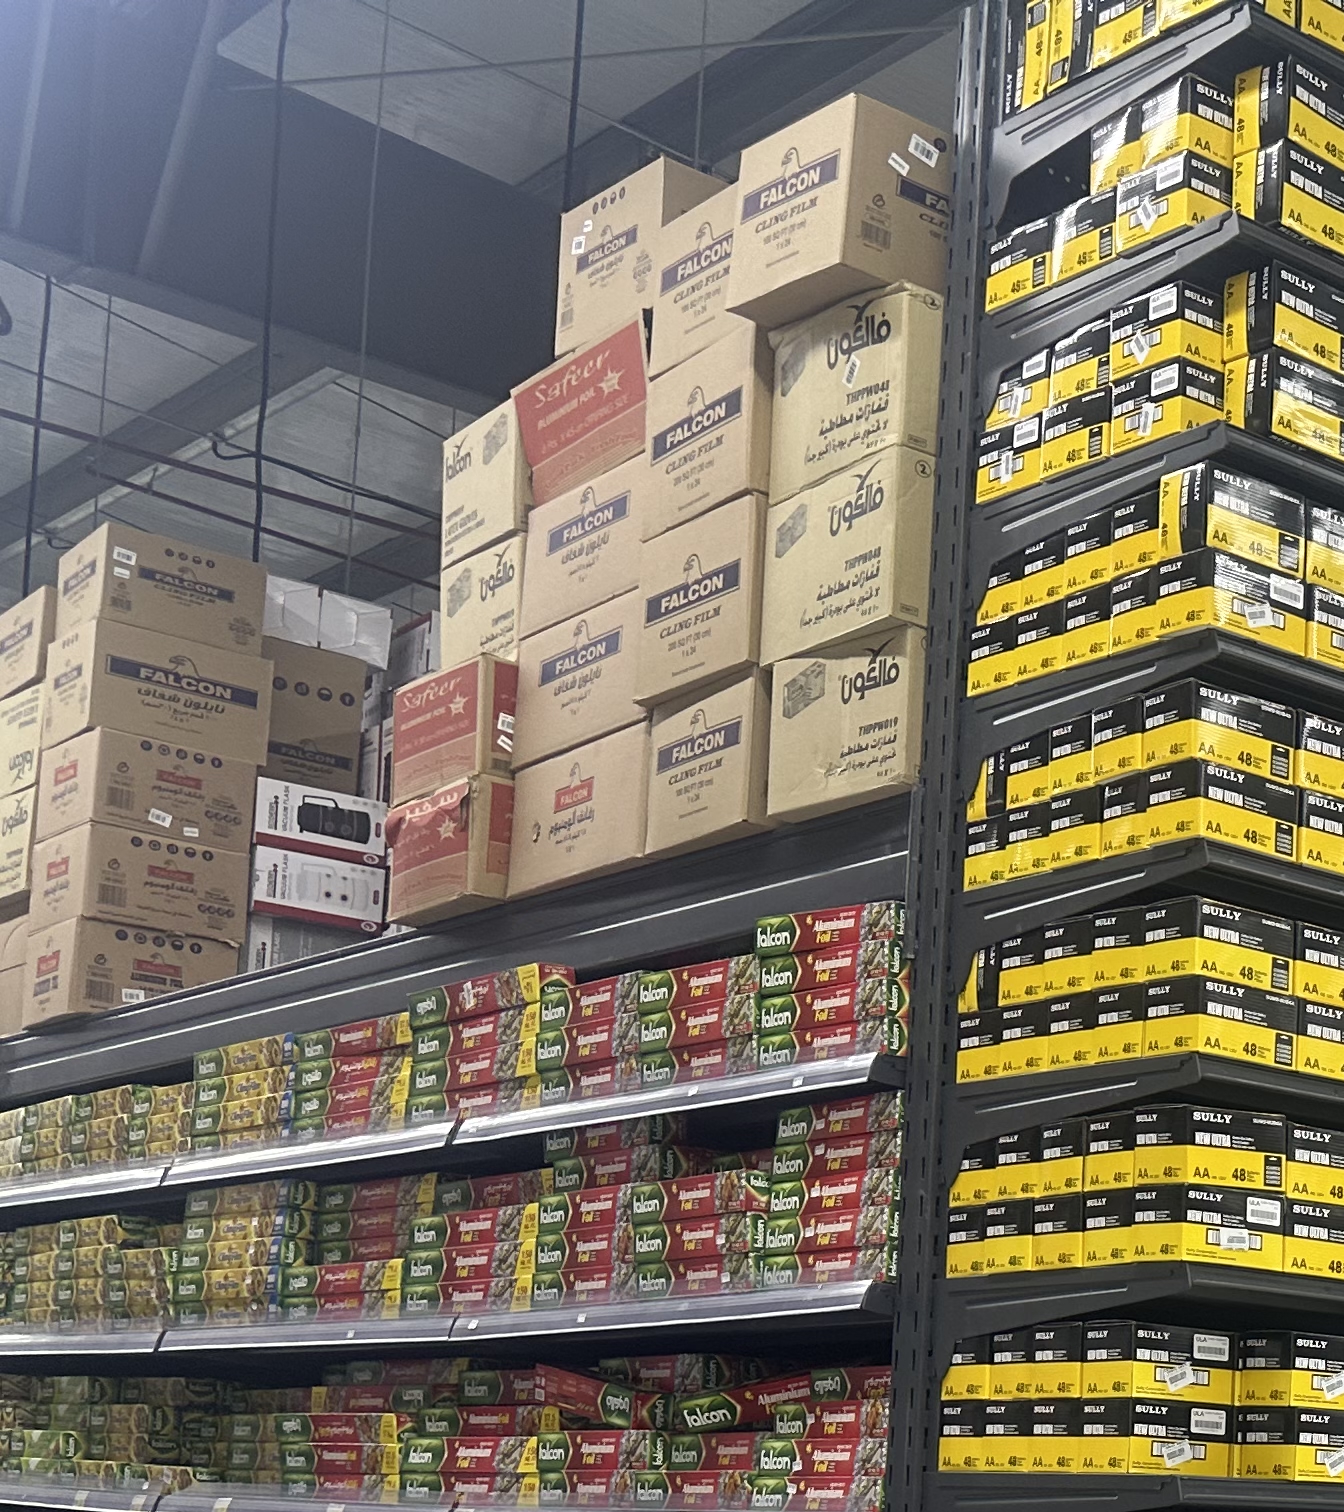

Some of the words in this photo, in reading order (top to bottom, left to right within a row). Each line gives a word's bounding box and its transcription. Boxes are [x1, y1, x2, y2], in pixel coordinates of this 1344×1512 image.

[1296, 64, 1328, 91] SULLY
[1293, 122, 1307, 141] AA
[1324, 140, 1337, 158] 48
[759, 166, 821, 209] FALCON
[755, 211, 787, 234] CLING
[789, 196, 818, 221] FILM
[587, 235, 627, 264] FALCON
[677, 238, 732, 282] FALCON
[674, 283, 702, 304] CLING
[827, 314, 891, 369] فالكون
[534, 352, 610, 408] Safeer
[666, 402, 727, 449] FALCON
[666, 449, 694, 474] CLING
[695, 435, 725, 460] FILM
[828, 482, 884, 536] فالكون
[563, 507, 613, 542] FALCON
[155, 573, 218, 596] FALCON
[661, 574, 724, 613] FALCON
[660, 619, 693, 639] CLING
[693, 605, 722, 627] FILM
[556, 642, 606, 674] FALCON
[139, 667, 232, 700] FALCON
[841, 656, 900, 704] فالكون
[401, 676, 462, 712] Safeer
[1199, 686, 1240, 706] SULLY
[672, 730, 725, 763] FALCON
[1198, 742, 1216, 757] AA
[1237, 750, 1252, 766] 48
[668, 767, 697, 786] CLING
[698, 757, 724, 776] FILM
[1206, 765, 1245, 784] SULLY
[560, 787, 588, 806] FALCON
[1307, 795, 1344, 813] SULLY
[1205, 820, 1222, 835] AA
[1243, 829, 1258, 844] 48
[1202, 904, 1241, 921] SULLY
[757, 926, 792, 949] falcon
[1303, 929, 1341, 945] SULLY
[762, 967, 793, 989] falcon
[1200, 960, 1218, 973] AA
[1239, 966, 1254, 981] 48
[640, 984, 670, 1003] falcon
[1193, 1111, 1233, 1124] SULLY
[1293, 1129, 1332, 1143] SULLY
[1193, 1166, 1210, 1180] AA
[1231, 1168, 1246, 1182] 48
[1292, 1182, 1309, 1195] AA
[1329, 1185, 1344, 1199] 48
[684, 1404, 732, 1428] falcon
[761, 1452, 792, 1471] falcon
